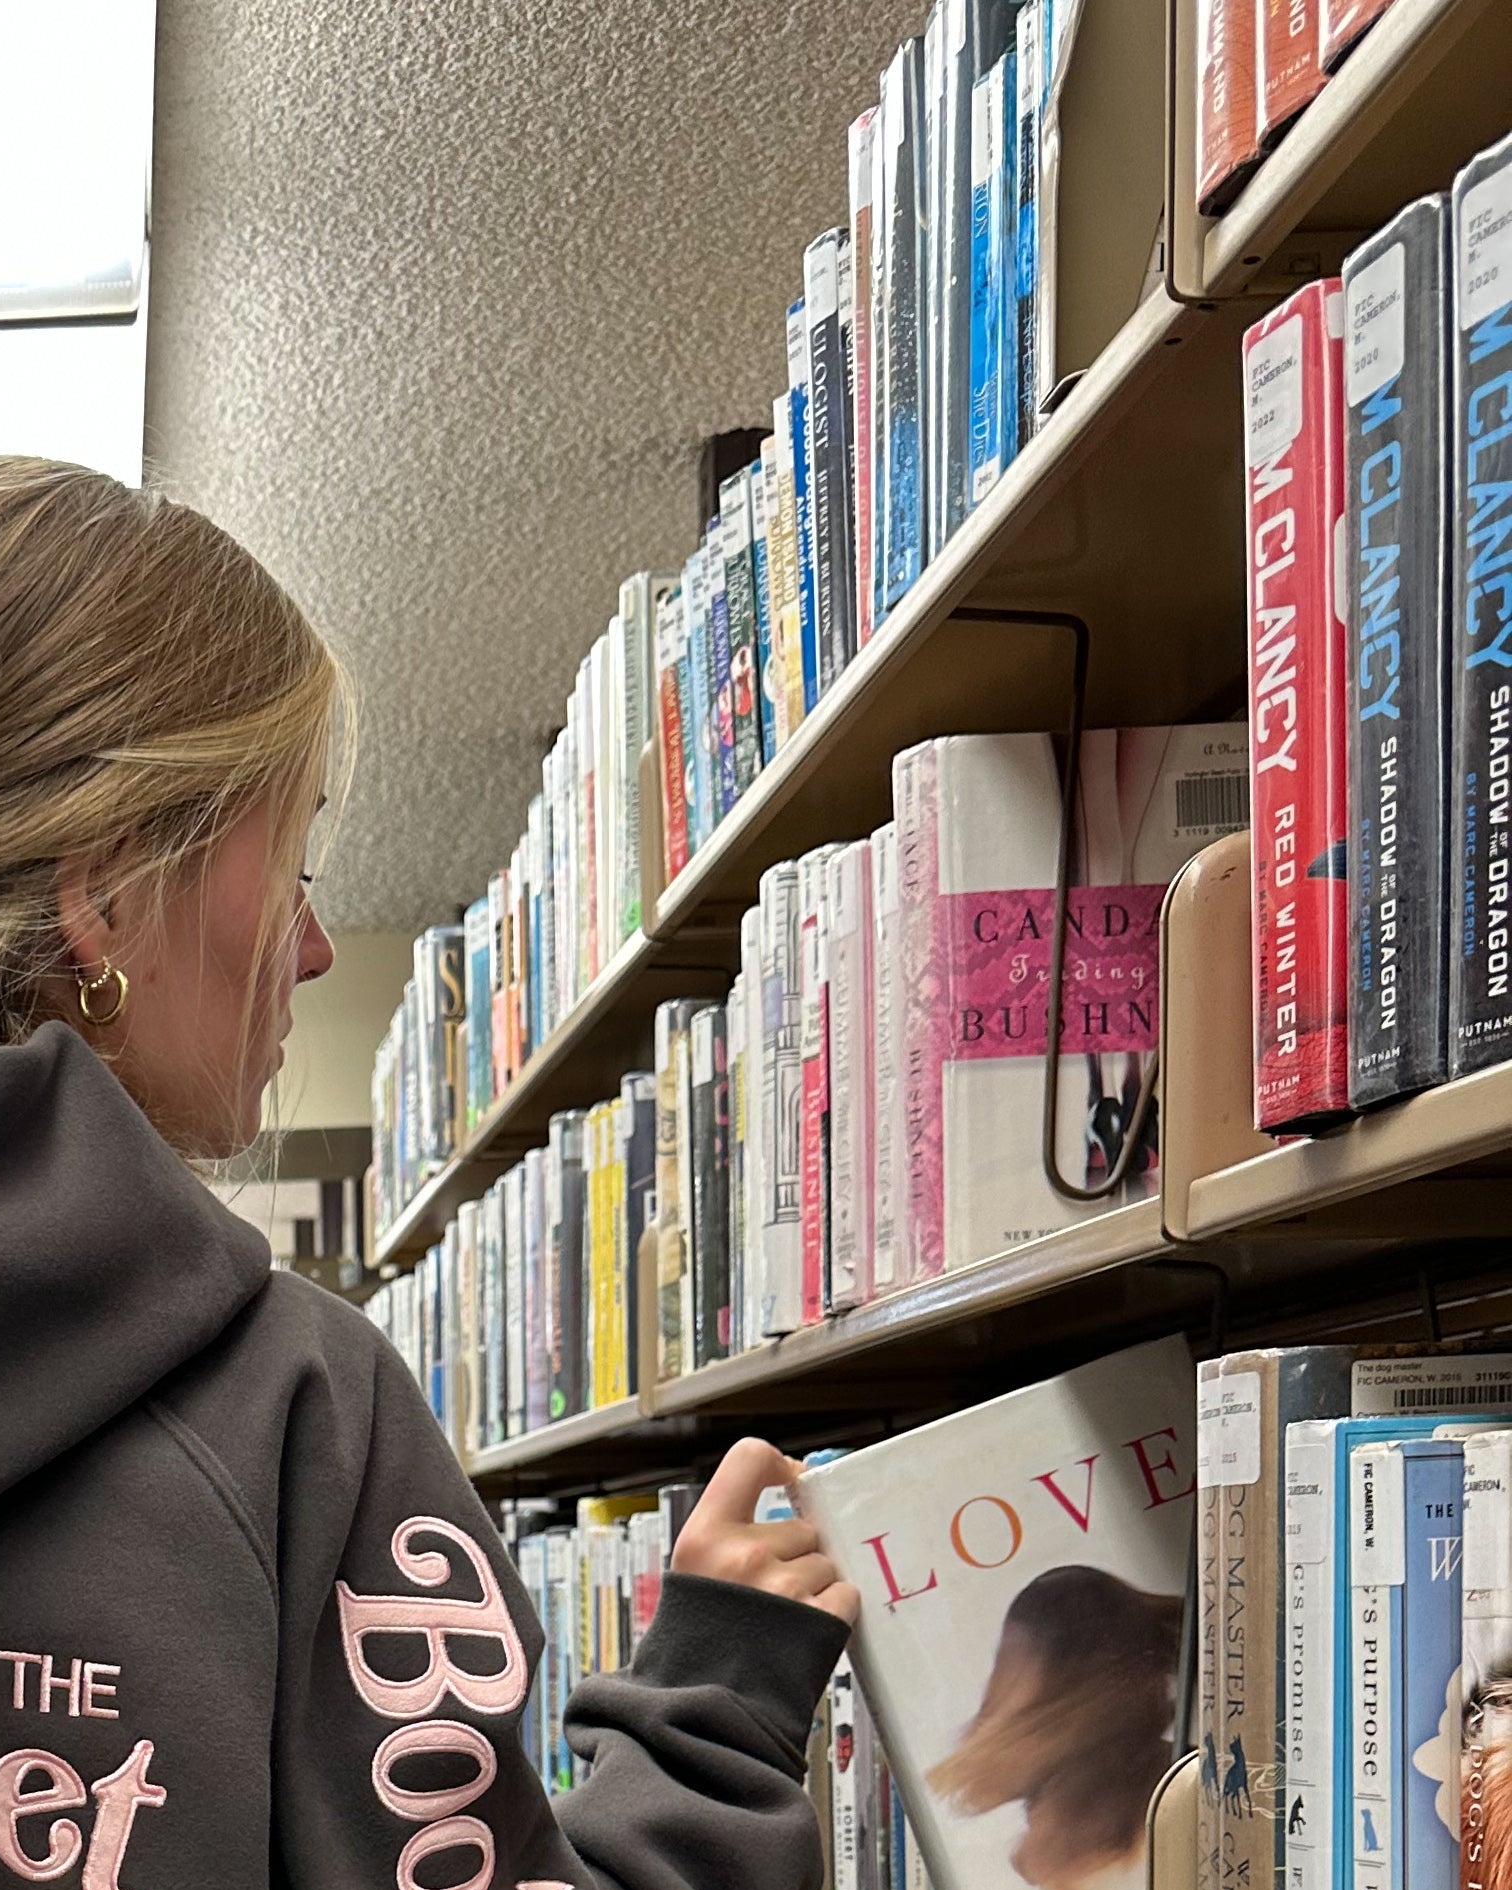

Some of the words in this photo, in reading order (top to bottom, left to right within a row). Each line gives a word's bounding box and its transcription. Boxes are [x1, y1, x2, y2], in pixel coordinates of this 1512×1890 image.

[1468, 266, 1499, 294] 2020
[1353, 348, 1379, 374] 2020
[1252, 409, 1276, 433] 2022
[1359, 441, 1400, 722] CLANCY
[1255, 508, 1298, 774] CLANCY
[1488, 685, 1510, 824] SHADOW
[1380, 736, 1398, 868] SHADOW
[1274, 804, 1296, 888] RED
[1488, 859, 1509, 998] DRAGON
[1009, 953, 1147, 989] Trding
[1274, 902, 1297, 1057] WINTER
[1380, 899, 1397, 1031] DRAGON
[1458, 1016, 1512, 1039] PUTNAM
[1358, 1047, 1401, 1070] PUTNAM
[1357, 1363, 1374, 1373] The
[1376, 1363, 1391, 1375] dog
[1394, 1361, 1423, 1372] master
[1357, 1376, 1375, 1386] FIC
[1363, 1462, 1374, 1480] FIC
[861, 1426, 1196, 1607] LOVE
[1363, 1481, 1375, 1536] CAMERON,
[1426, 1503, 1455, 1519] THE
[1201, 1557, 1217, 1712] MASTER
[1227, 1556, 1246, 1726] MASTER
[1470, 1700, 1485, 1724] A
[843, 1804, 854, 1861] ROBERT
[1468, 1744, 1484, 1864] DOG'S
